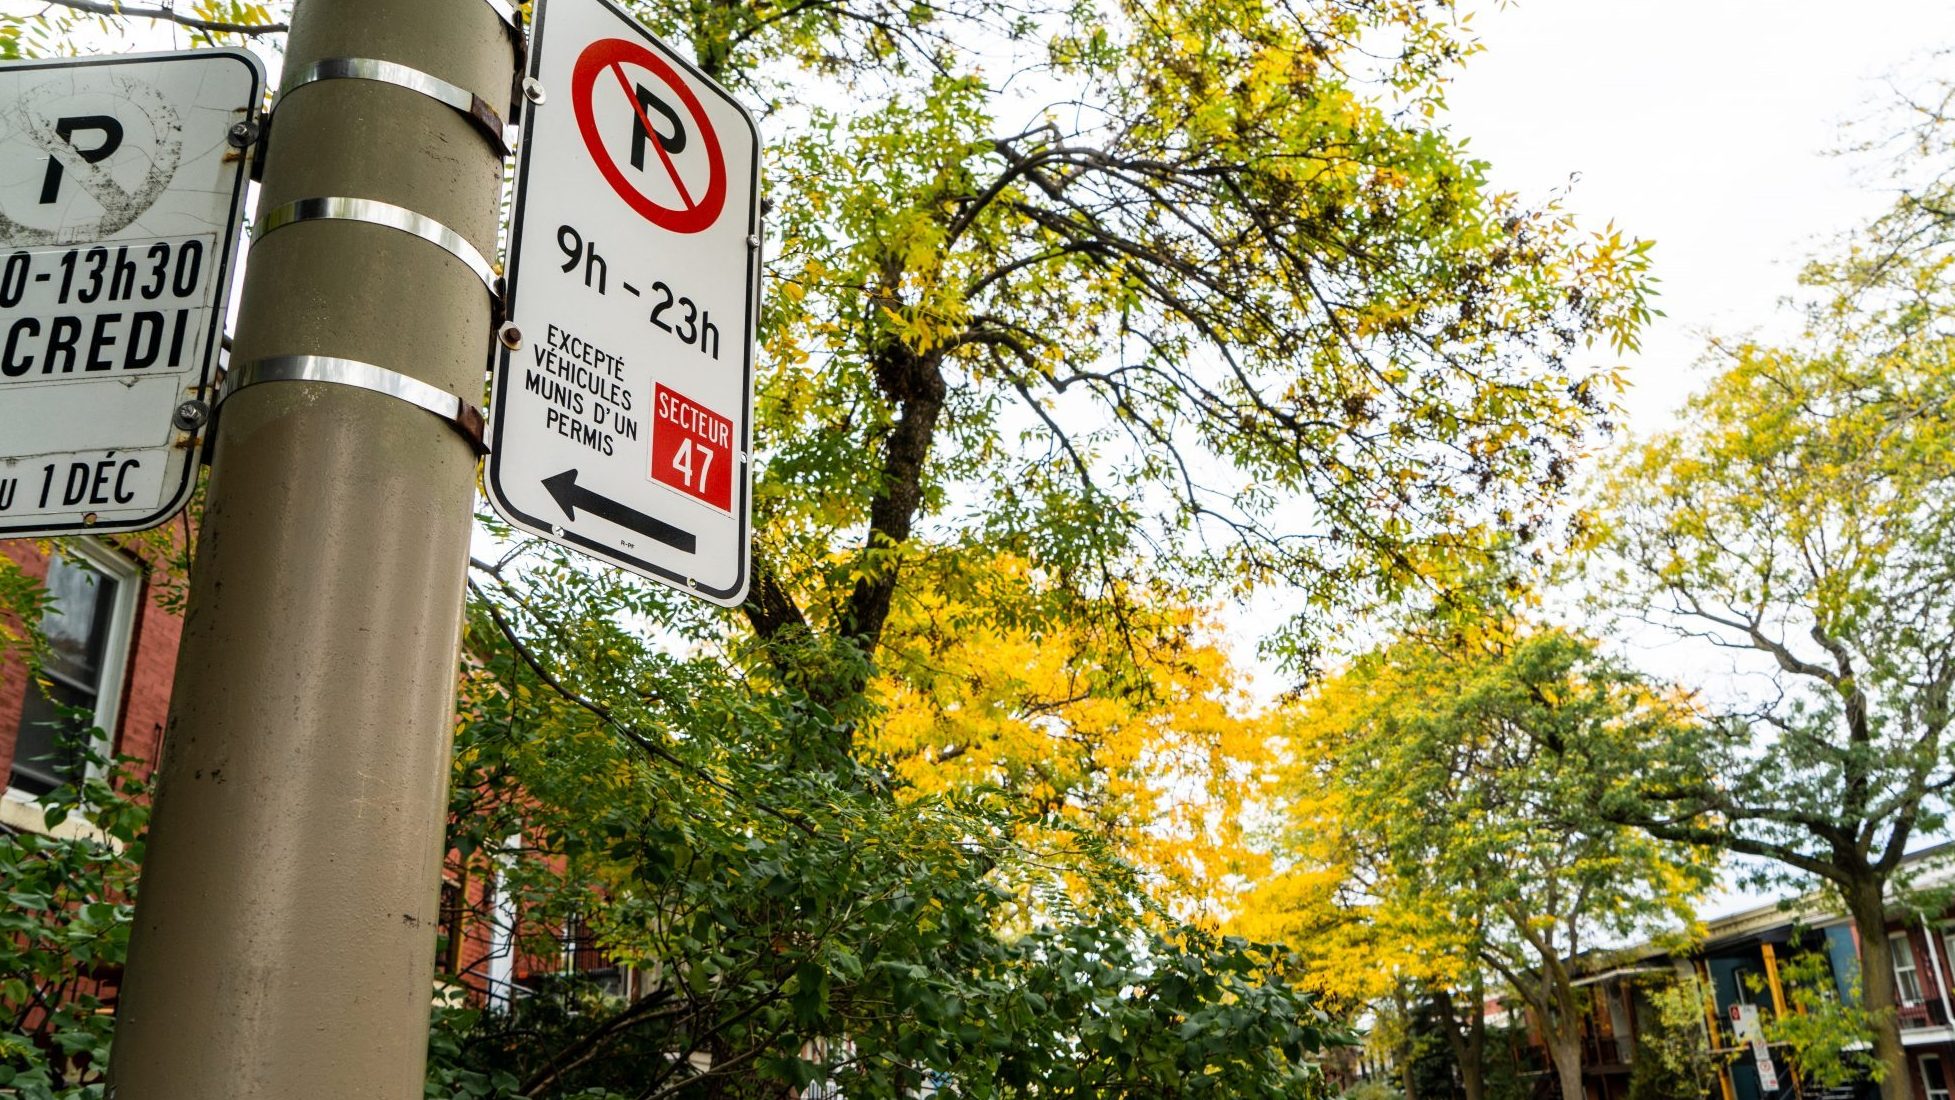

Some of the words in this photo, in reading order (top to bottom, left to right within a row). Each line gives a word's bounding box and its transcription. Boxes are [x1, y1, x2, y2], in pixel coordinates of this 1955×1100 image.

[557, 224, 607, 295] 9h
[650, 281, 719, 359] 23h
[2, 309, 189, 377] CREDI
[548, 323, 625, 382] EXCEPTÉ
[525, 369, 583, 415] MUNIS
[534, 344, 632, 411] VÉHICULES
[546, 407, 614, 457] PERMIS
[659, 392, 729, 449] SECTEUR
[38, 463, 56, 508] 1
[62, 451, 140, 506] DÉC
[672, 438, 714, 494] 47
